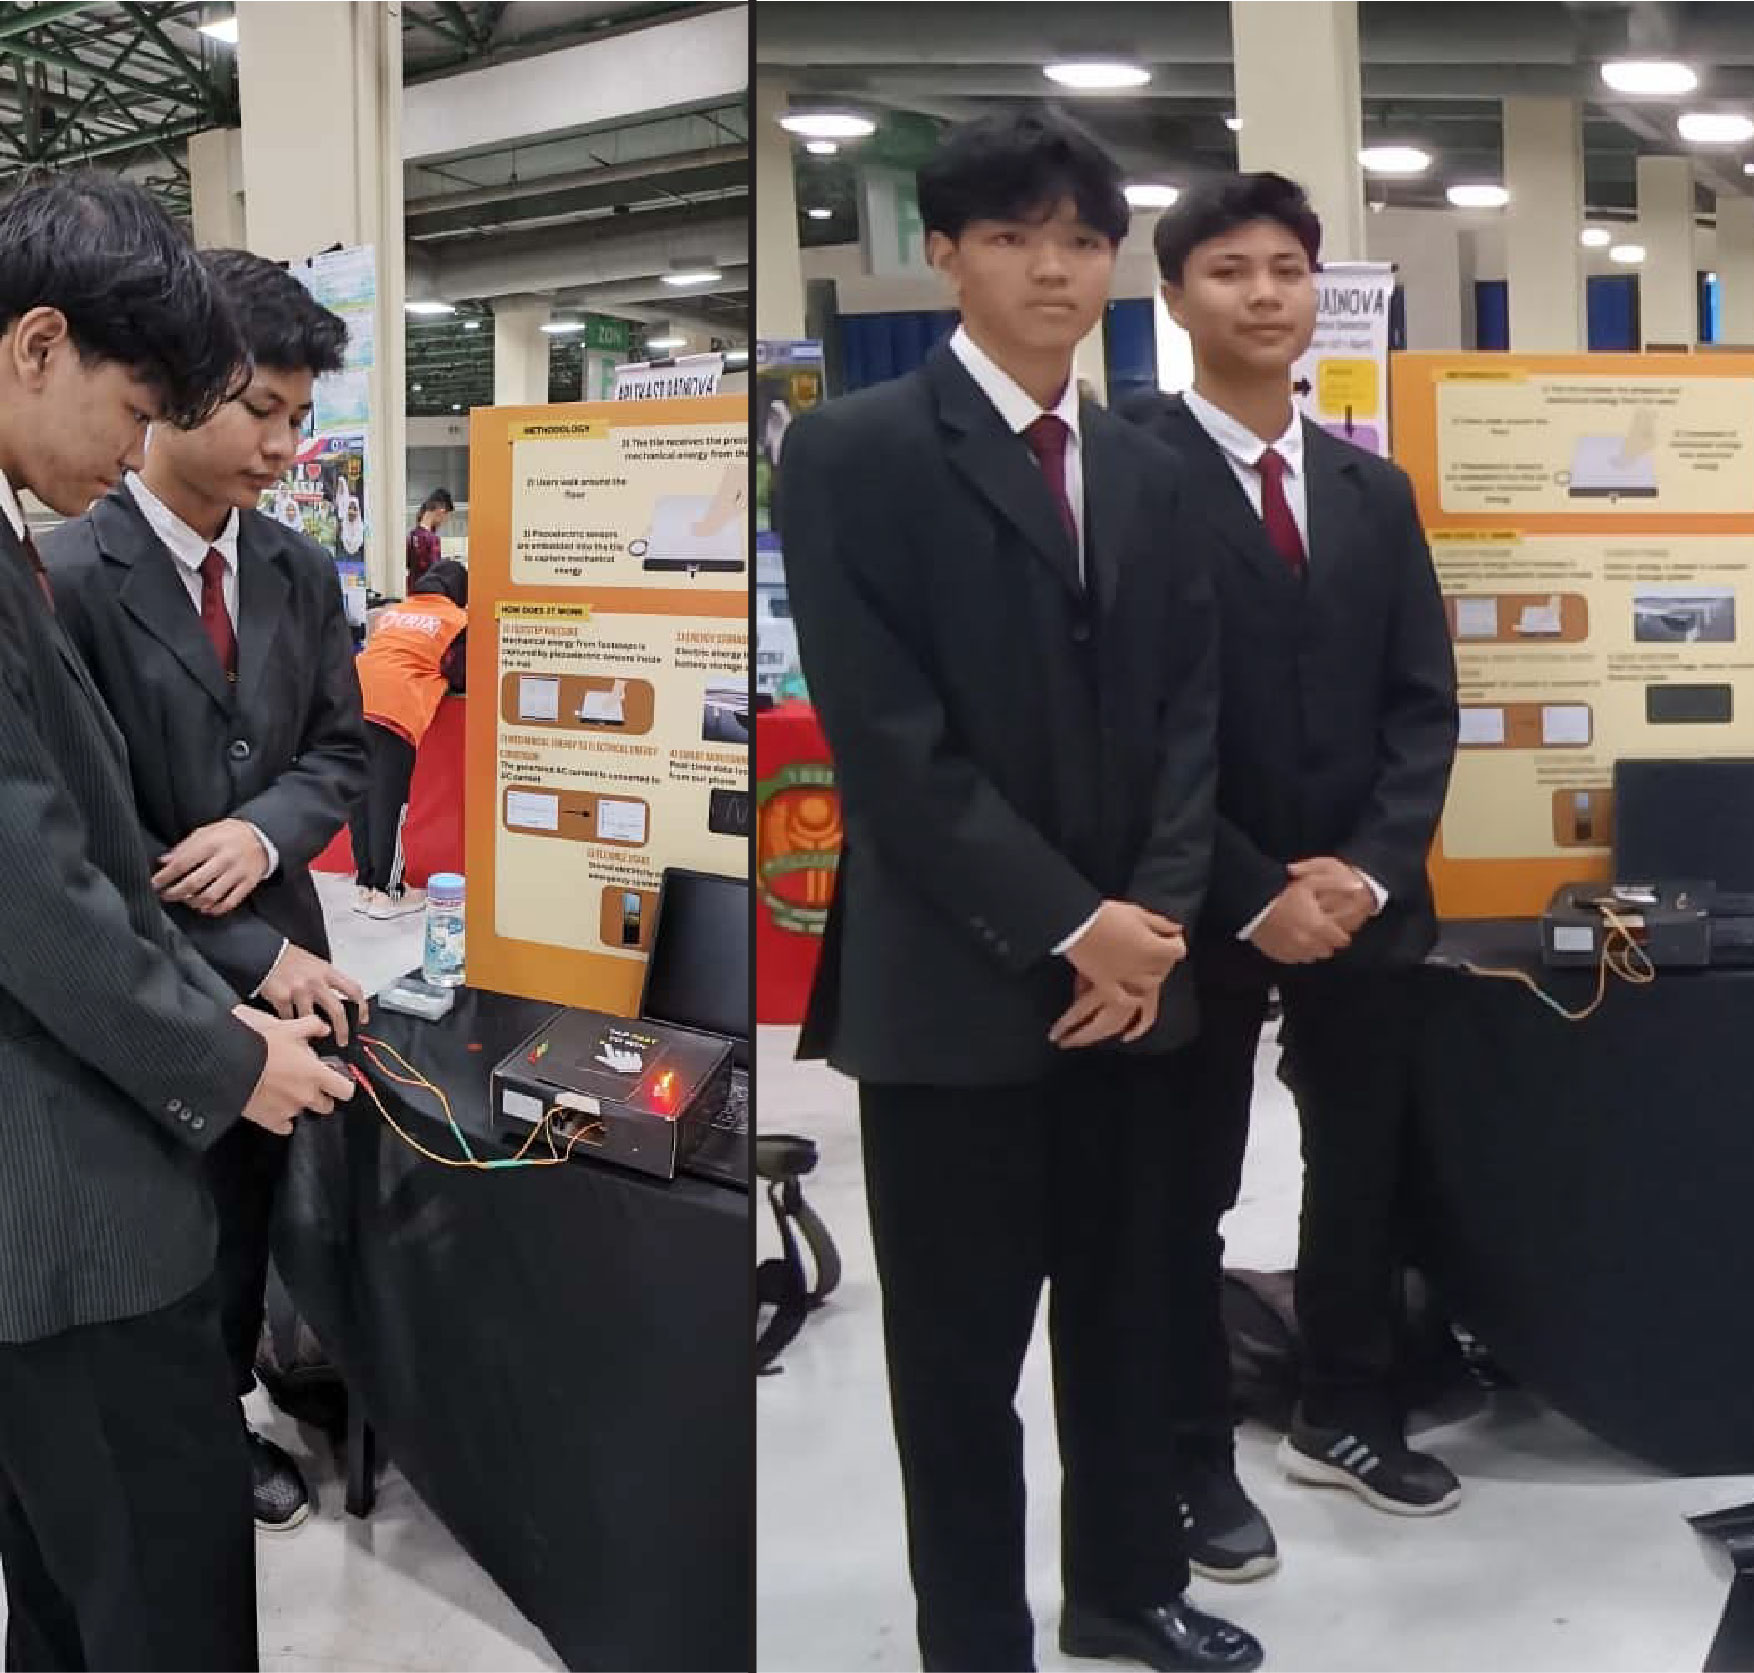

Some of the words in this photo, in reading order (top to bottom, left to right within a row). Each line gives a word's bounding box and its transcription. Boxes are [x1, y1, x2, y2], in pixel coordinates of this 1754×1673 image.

[523, 423, 590, 435] METHODOLOGY
[624, 450, 675, 461] mechanical
[677, 450, 707, 463] energy
[522, 606, 545, 616] DOES
